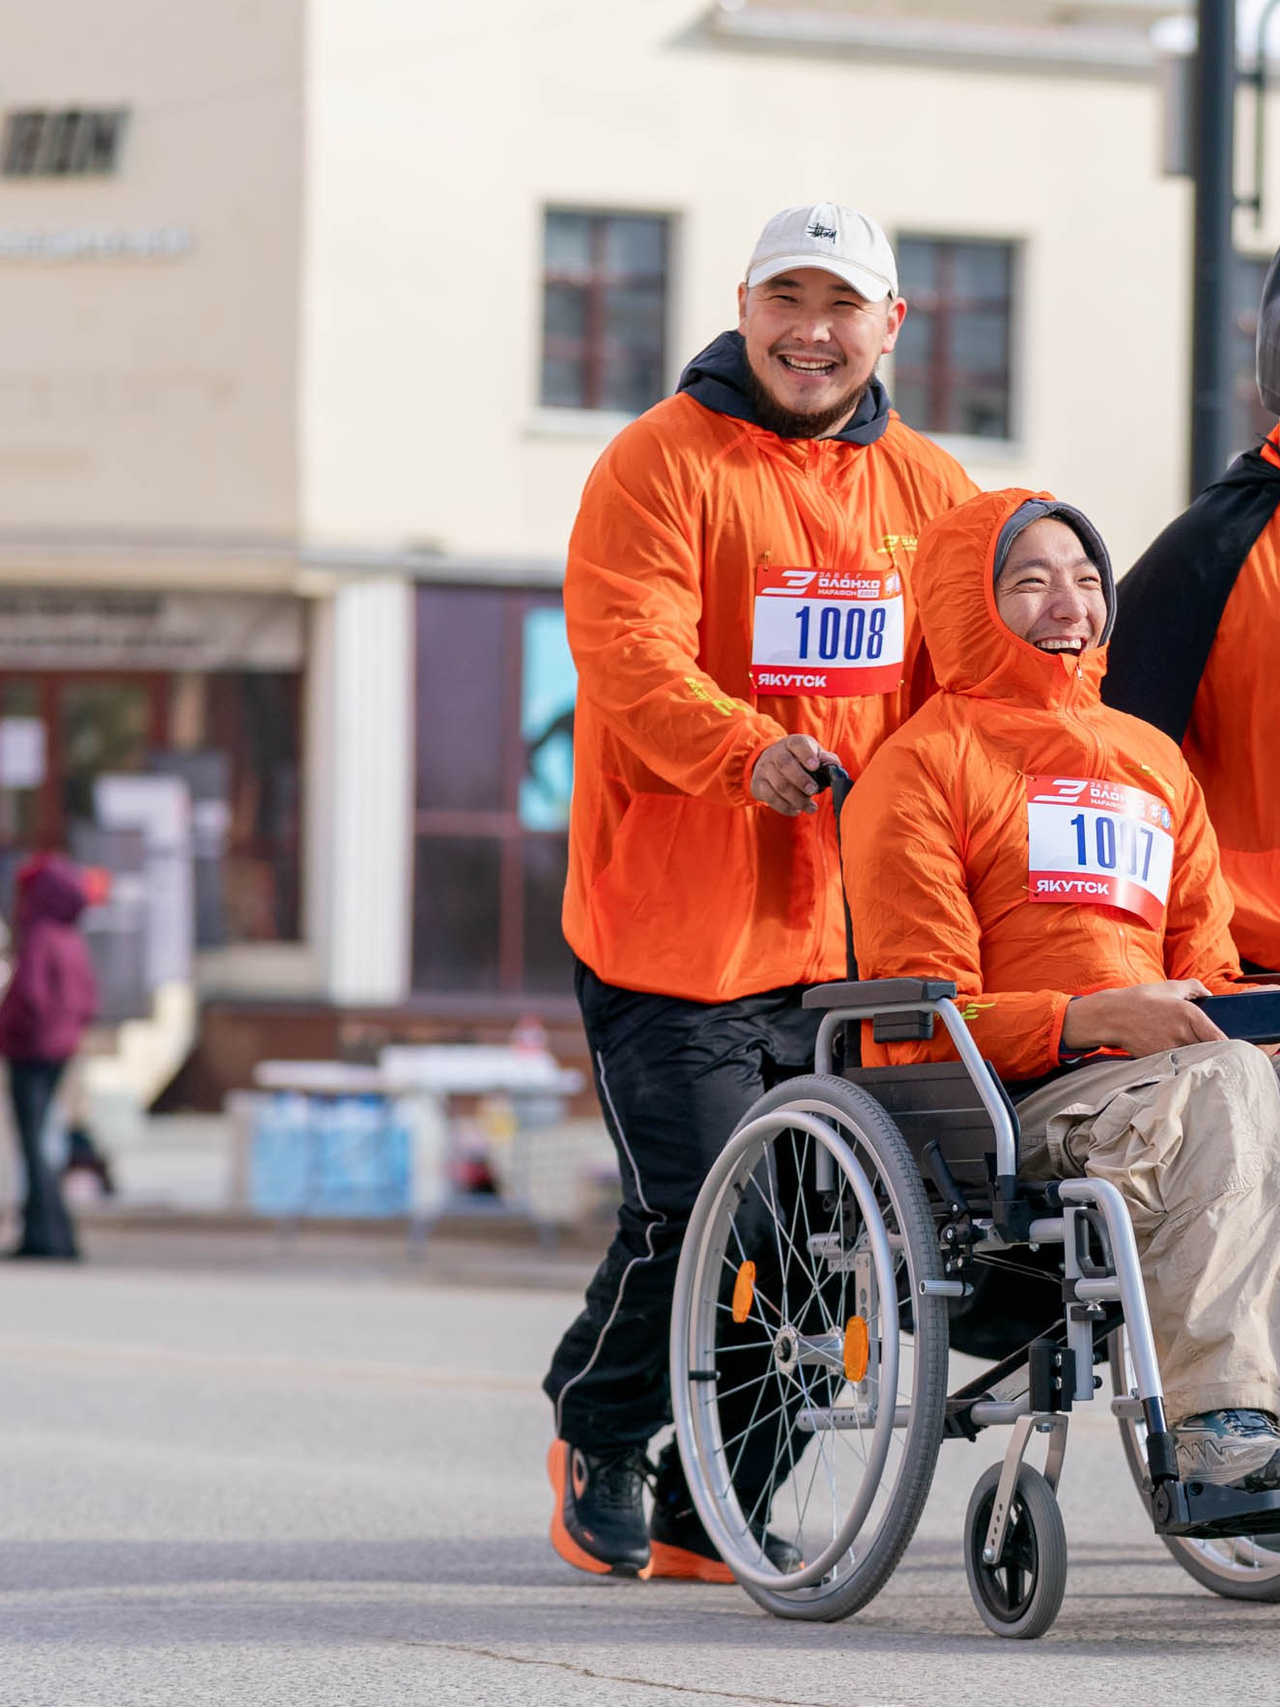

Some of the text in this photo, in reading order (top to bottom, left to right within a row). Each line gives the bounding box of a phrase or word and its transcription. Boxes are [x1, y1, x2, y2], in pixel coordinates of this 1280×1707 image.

[818, 578, 881, 589] ОЛОНХО
[795, 606, 886, 660] 1008
[758, 673, 827, 688] ЯКУТСК
[1036, 880, 1109, 895] ЯКУТСК
